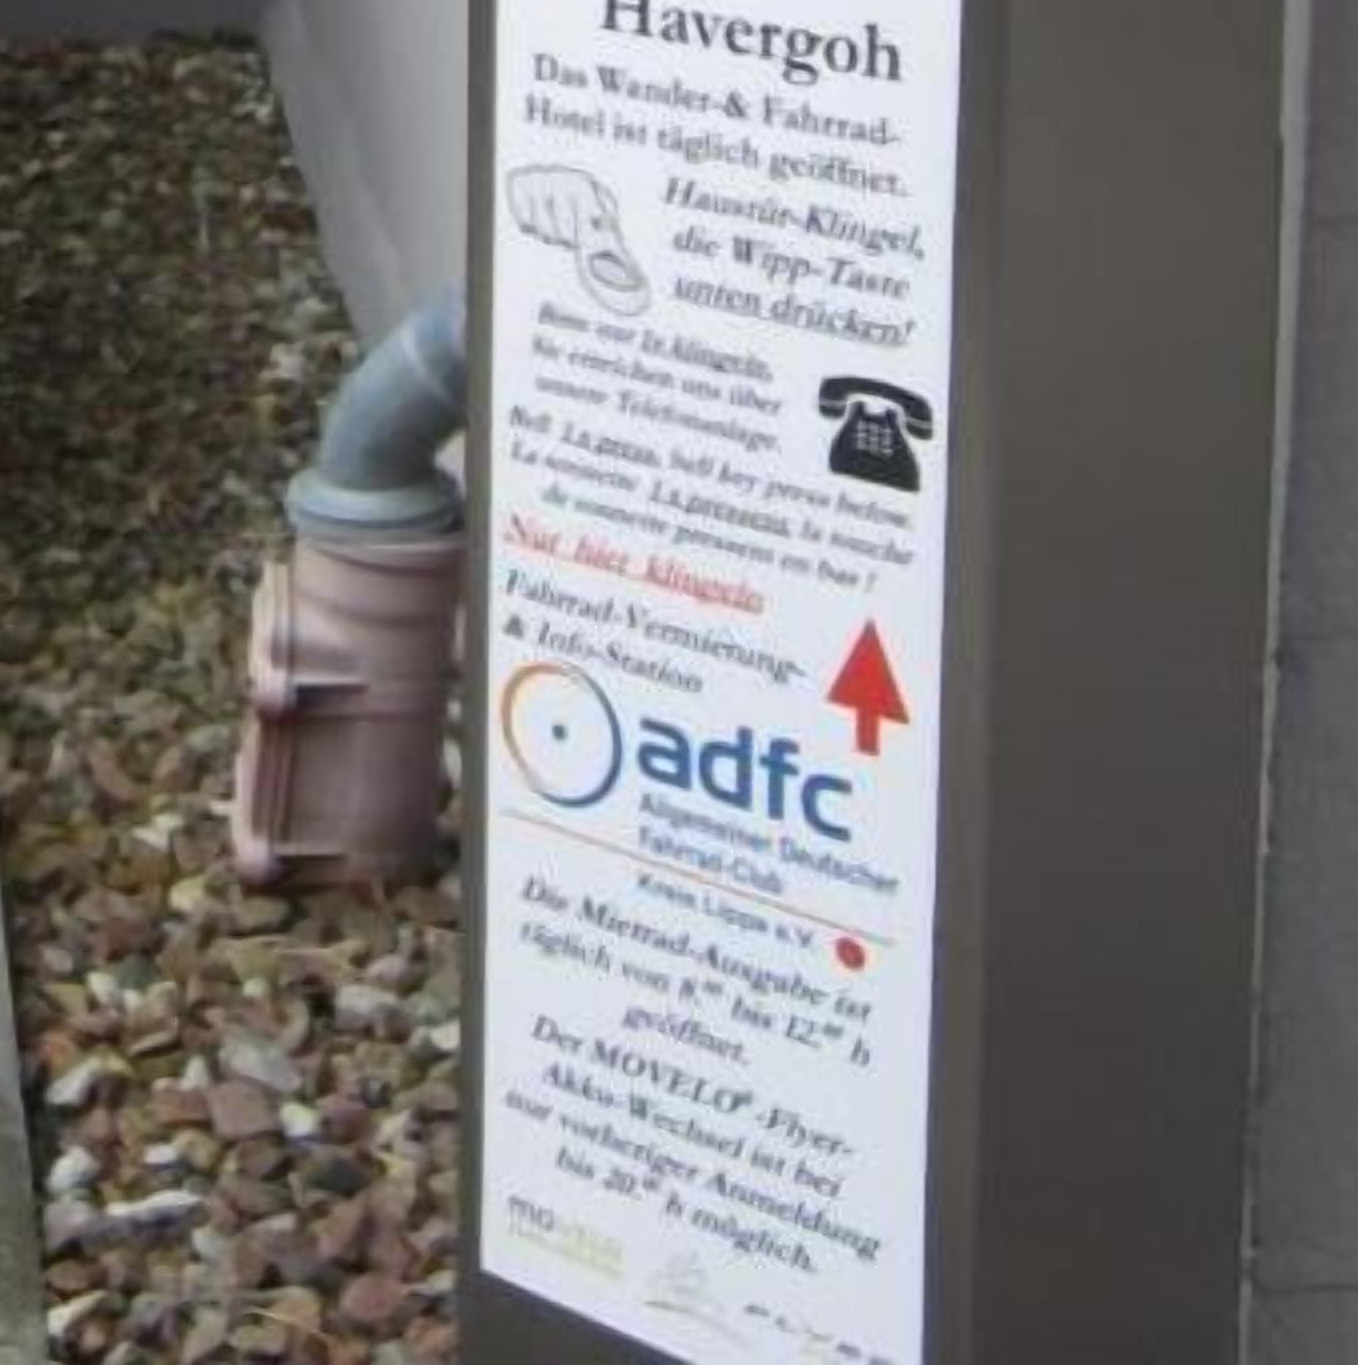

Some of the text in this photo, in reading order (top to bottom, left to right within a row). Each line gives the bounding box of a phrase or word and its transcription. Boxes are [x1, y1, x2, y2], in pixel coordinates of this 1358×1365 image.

[525, 93, 605, 138] Hotel
[657, 124, 760, 169] täglich
[533, 53, 589, 88] Das
[763, 94, 902, 147] Fahrrad-
[673, 225, 721, 257] die
[674, 274, 763, 318] unten
[638, 717, 853, 843] adfc
